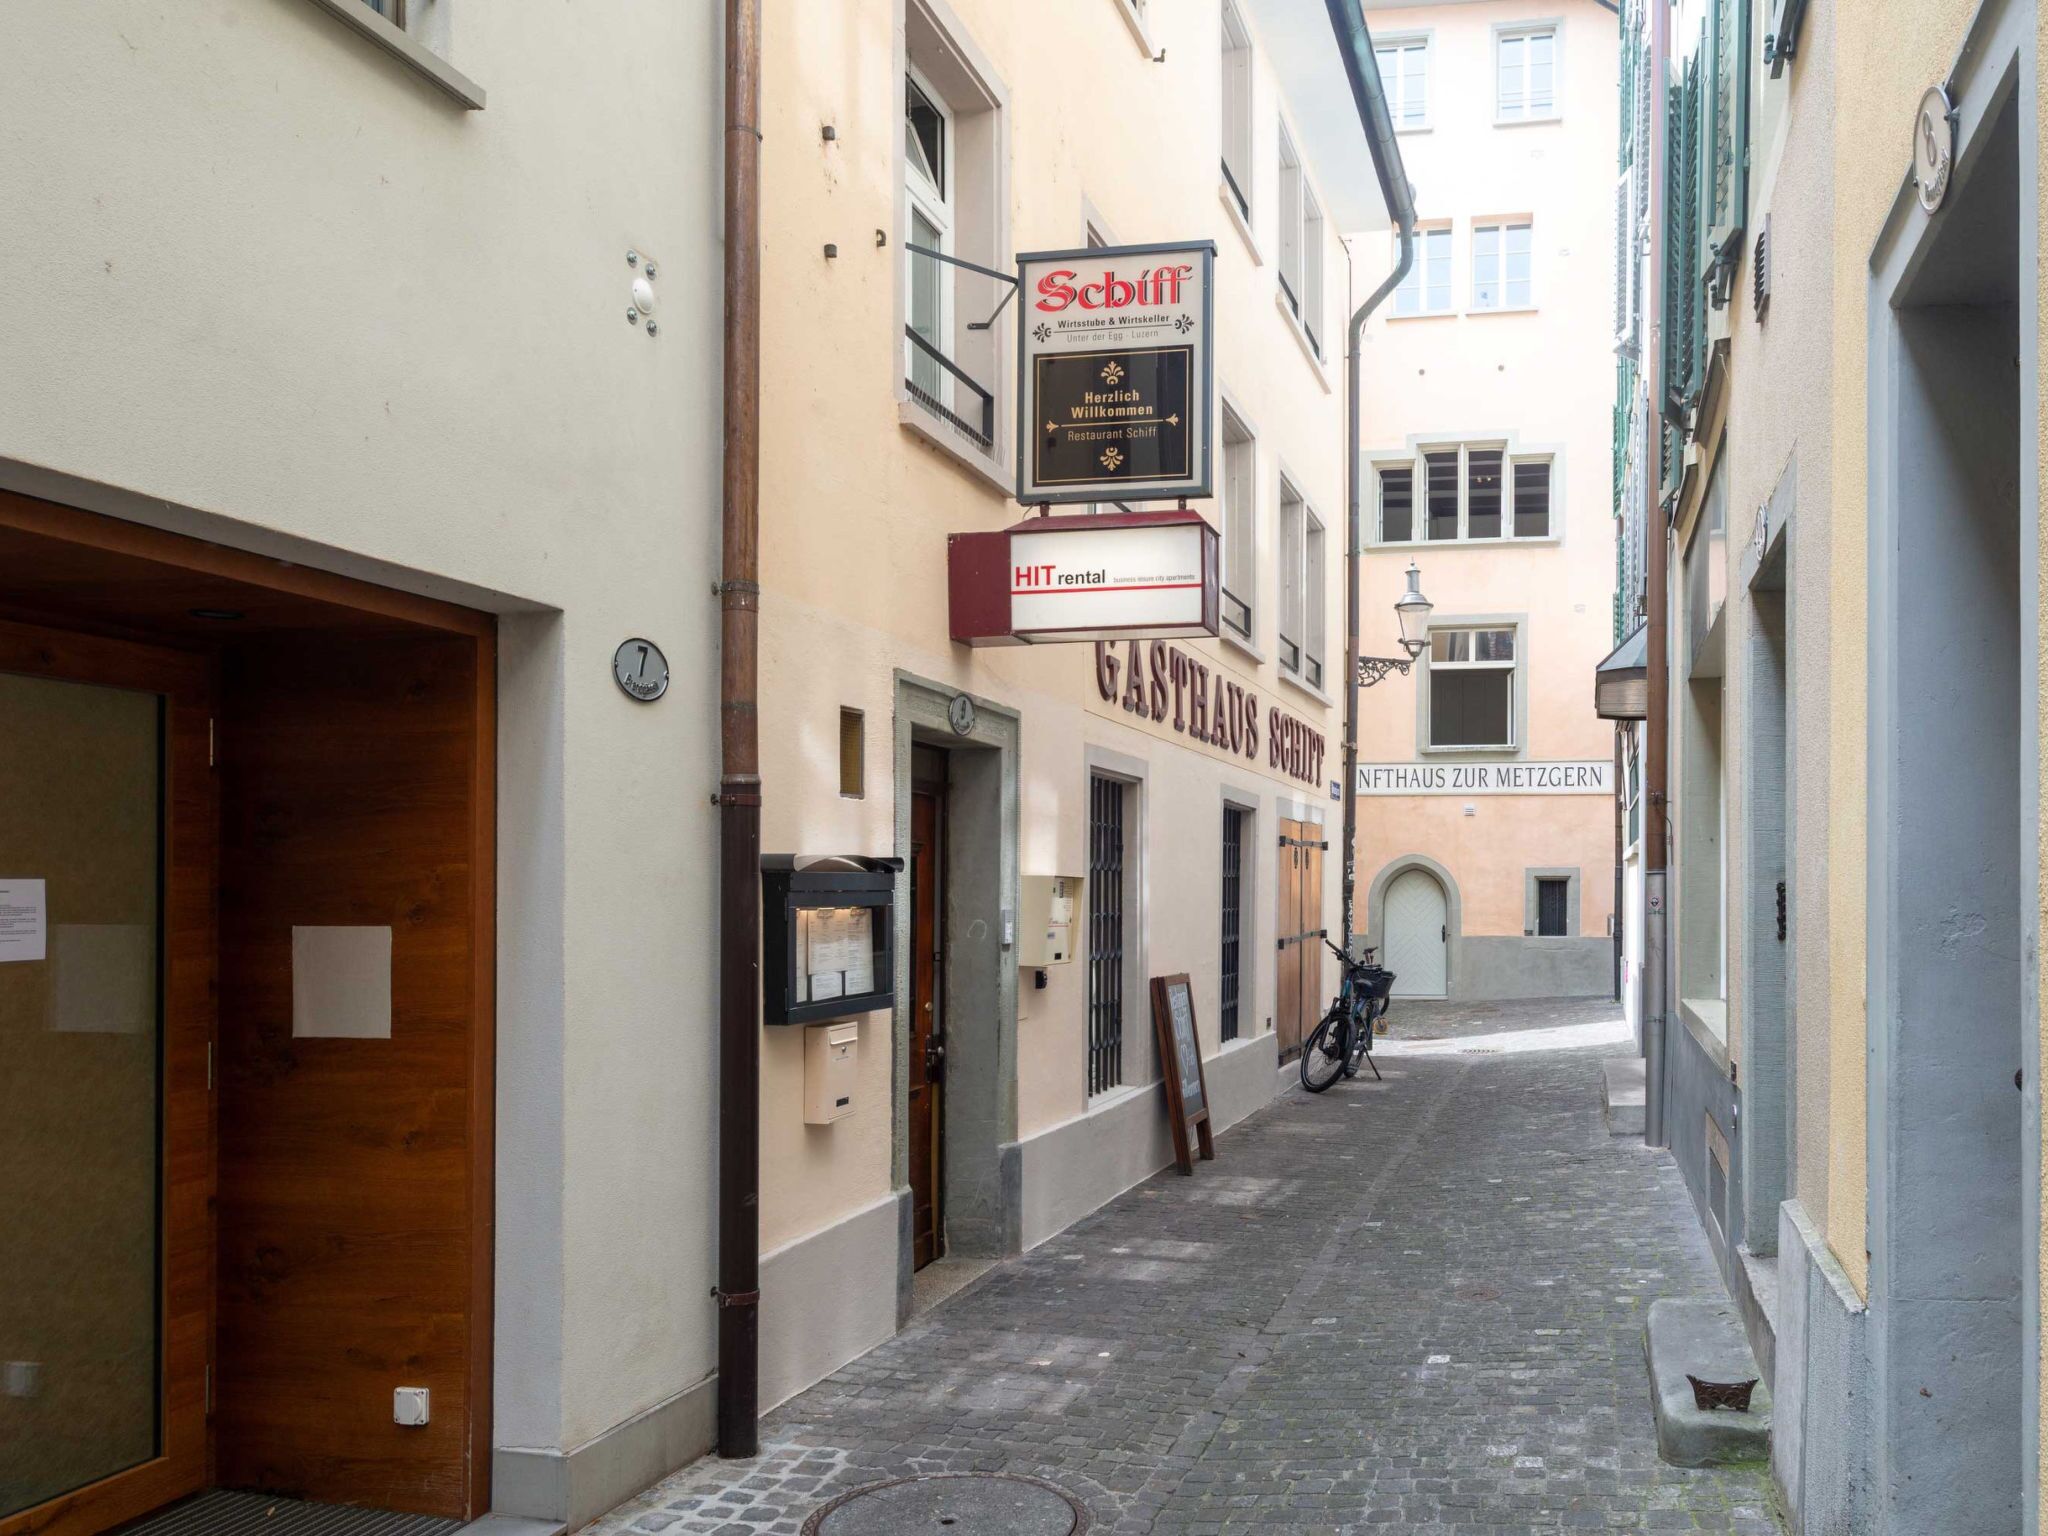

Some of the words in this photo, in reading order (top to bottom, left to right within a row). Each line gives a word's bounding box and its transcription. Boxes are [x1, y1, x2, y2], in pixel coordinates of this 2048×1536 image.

[1035, 264, 1193, 312] Schiff
[1057, 318, 1106, 329] Wirtsstube
[1108, 317, 1115, 325] &
[1119, 314, 1169, 325] Wirtskeller
[1067, 333, 1089, 343] Unter
[1092, 332, 1105, 341] der
[1109, 332, 1123, 341] Egg
[1131, 329, 1159, 339] Luzern
[1084, 389, 1140, 404] Herzlich
[1071, 405, 1153, 419] Willkommen
[1067, 429, 1123, 442] Restaurant
[1126, 426, 1158, 438] Schiff
[1014, 565, 1056, 587] HIT
[1057, 568, 1106, 586] rental
[637, 645, 648, 677] 7
[1095, 639, 1260, 761] GASTHAUS
[1269, 705, 1325, 788] SCHIFF
[1358, 767, 1445, 789] NFTHAUS
[1452, 767, 1488, 788] ZUR
[1496, 766, 1602, 788] METZGERN
